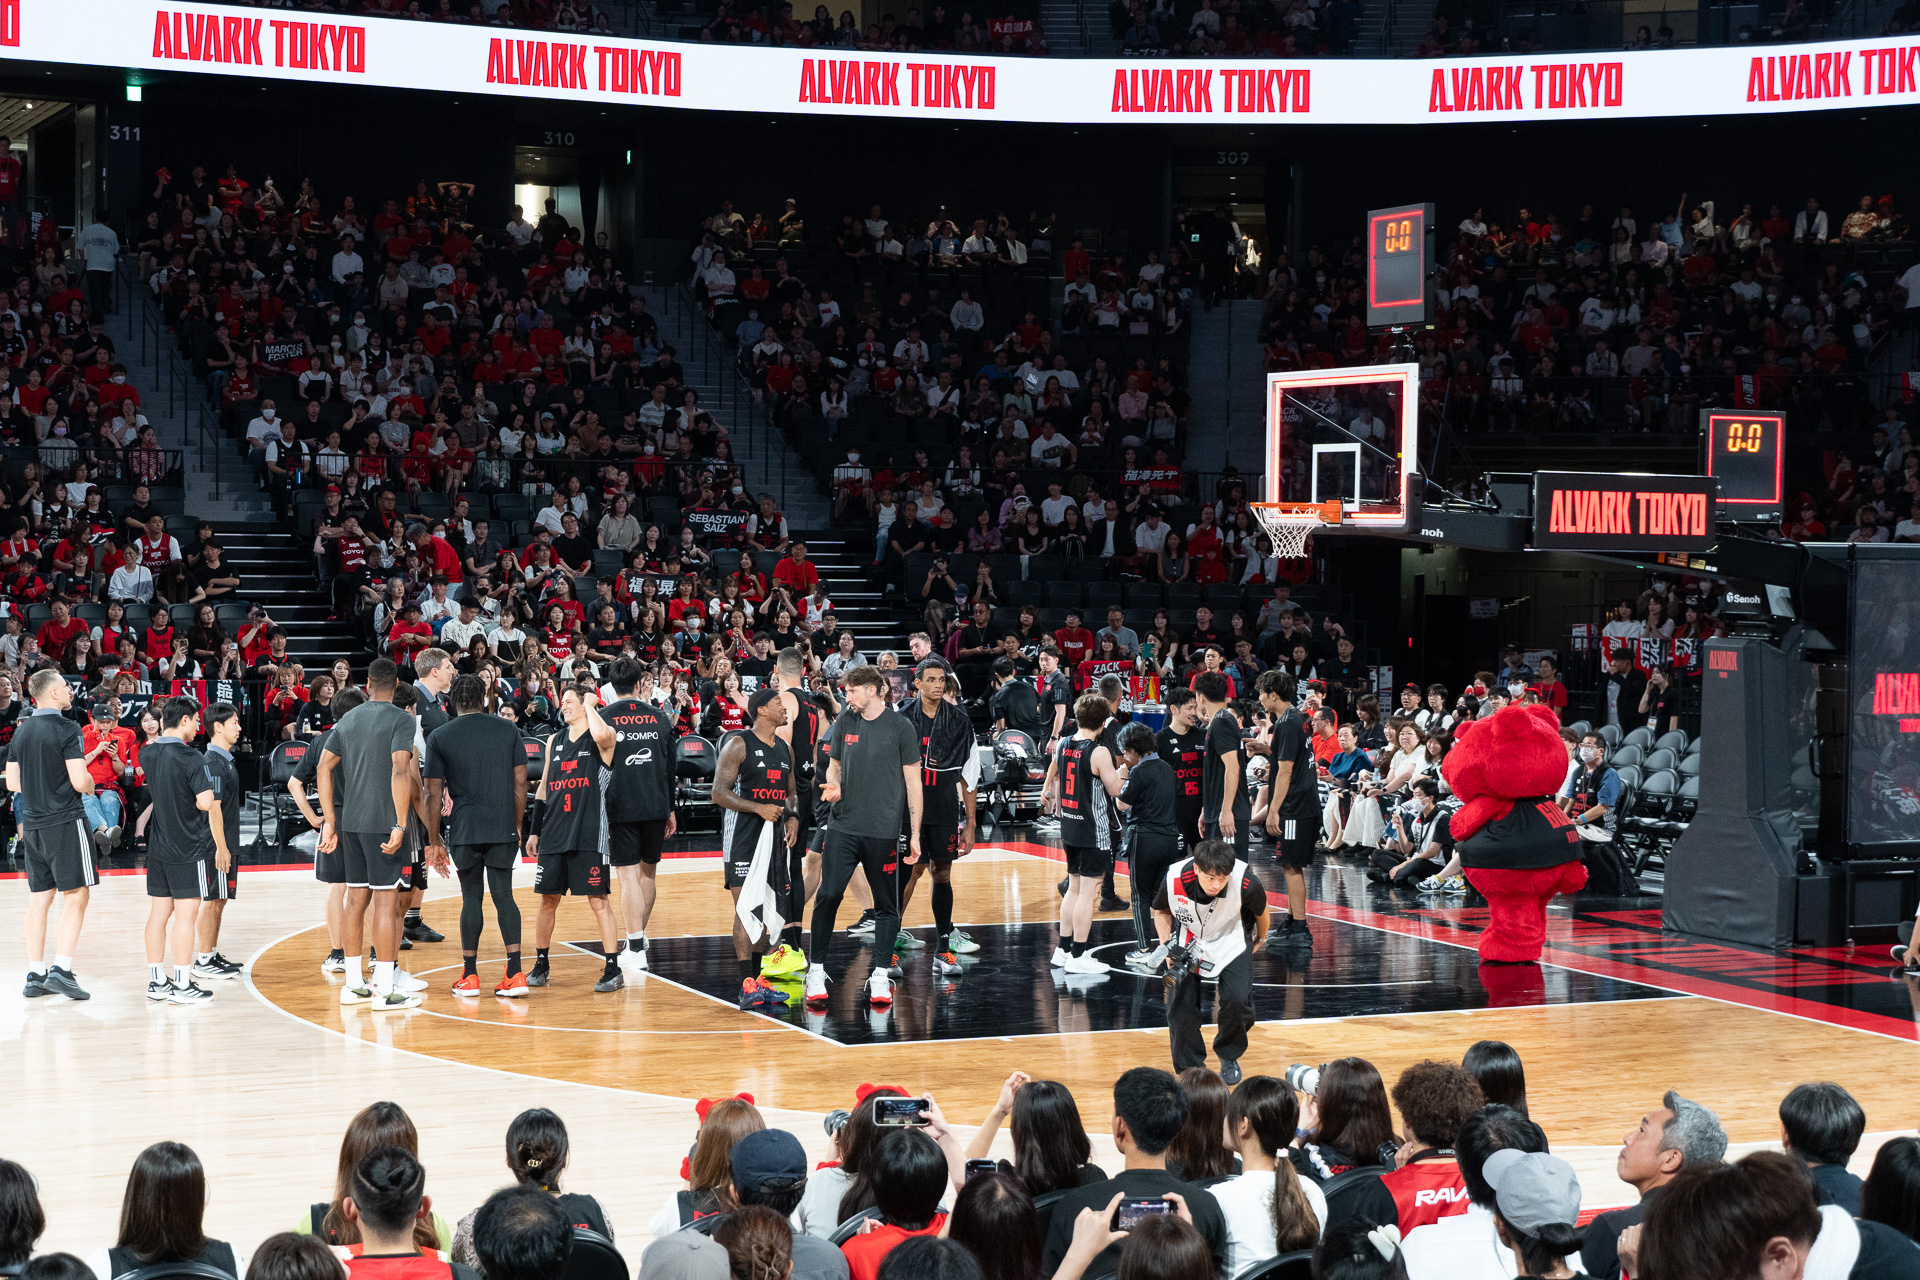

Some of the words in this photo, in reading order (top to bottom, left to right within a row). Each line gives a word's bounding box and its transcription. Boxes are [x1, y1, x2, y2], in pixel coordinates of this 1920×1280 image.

[153, 11, 262, 66] ALVARK
[270, 19, 366, 74] TOKYO
[486, 38, 588, 90] ALVARK
[594, 46, 681, 97] TOKYO
[1746, 51, 1852, 102] ALVARK
[1859, 45, 1920, 96] TOK
[799, 59, 900, 106] ALVARK
[906, 63, 996, 110] TOKYO
[1112, 69, 1213, 113] ALVARK
[1219, 69, 1311, 113] TOKYO
[1428, 66, 1523, 113] ALVARK
[1530, 62, 1623, 109] TOKYO
[110, 126, 141, 141] 311
[544, 131, 575, 146] 310
[1216, 152, 1249, 165] 309
[1727, 423, 1762, 453] 0.0
[688, 513, 746, 525] SEBASTIAN
[1549, 489, 1632, 534] ALVARK
[1635, 492, 1707, 536] TOKYO
[703, 523, 727, 533] SAIZ
[1421, 528, 1444, 538] noh
[1733, 594, 1761, 604] Senoh
[1093, 661, 1120, 674] ZACK
[1708, 650, 1738, 671] ALVARK
[1872, 672, 1920, 715] ALVA
[612, 714, 658, 726] TOYOTA
[626, 731, 659, 741] SOMPO
[549, 776, 590, 792] TOYOTA
[1065, 761, 1076, 795] 5
[1184, 781, 1199, 796] 25
[563, 793, 572, 812] 3
[1414, 1187, 1470, 1206] RAV
